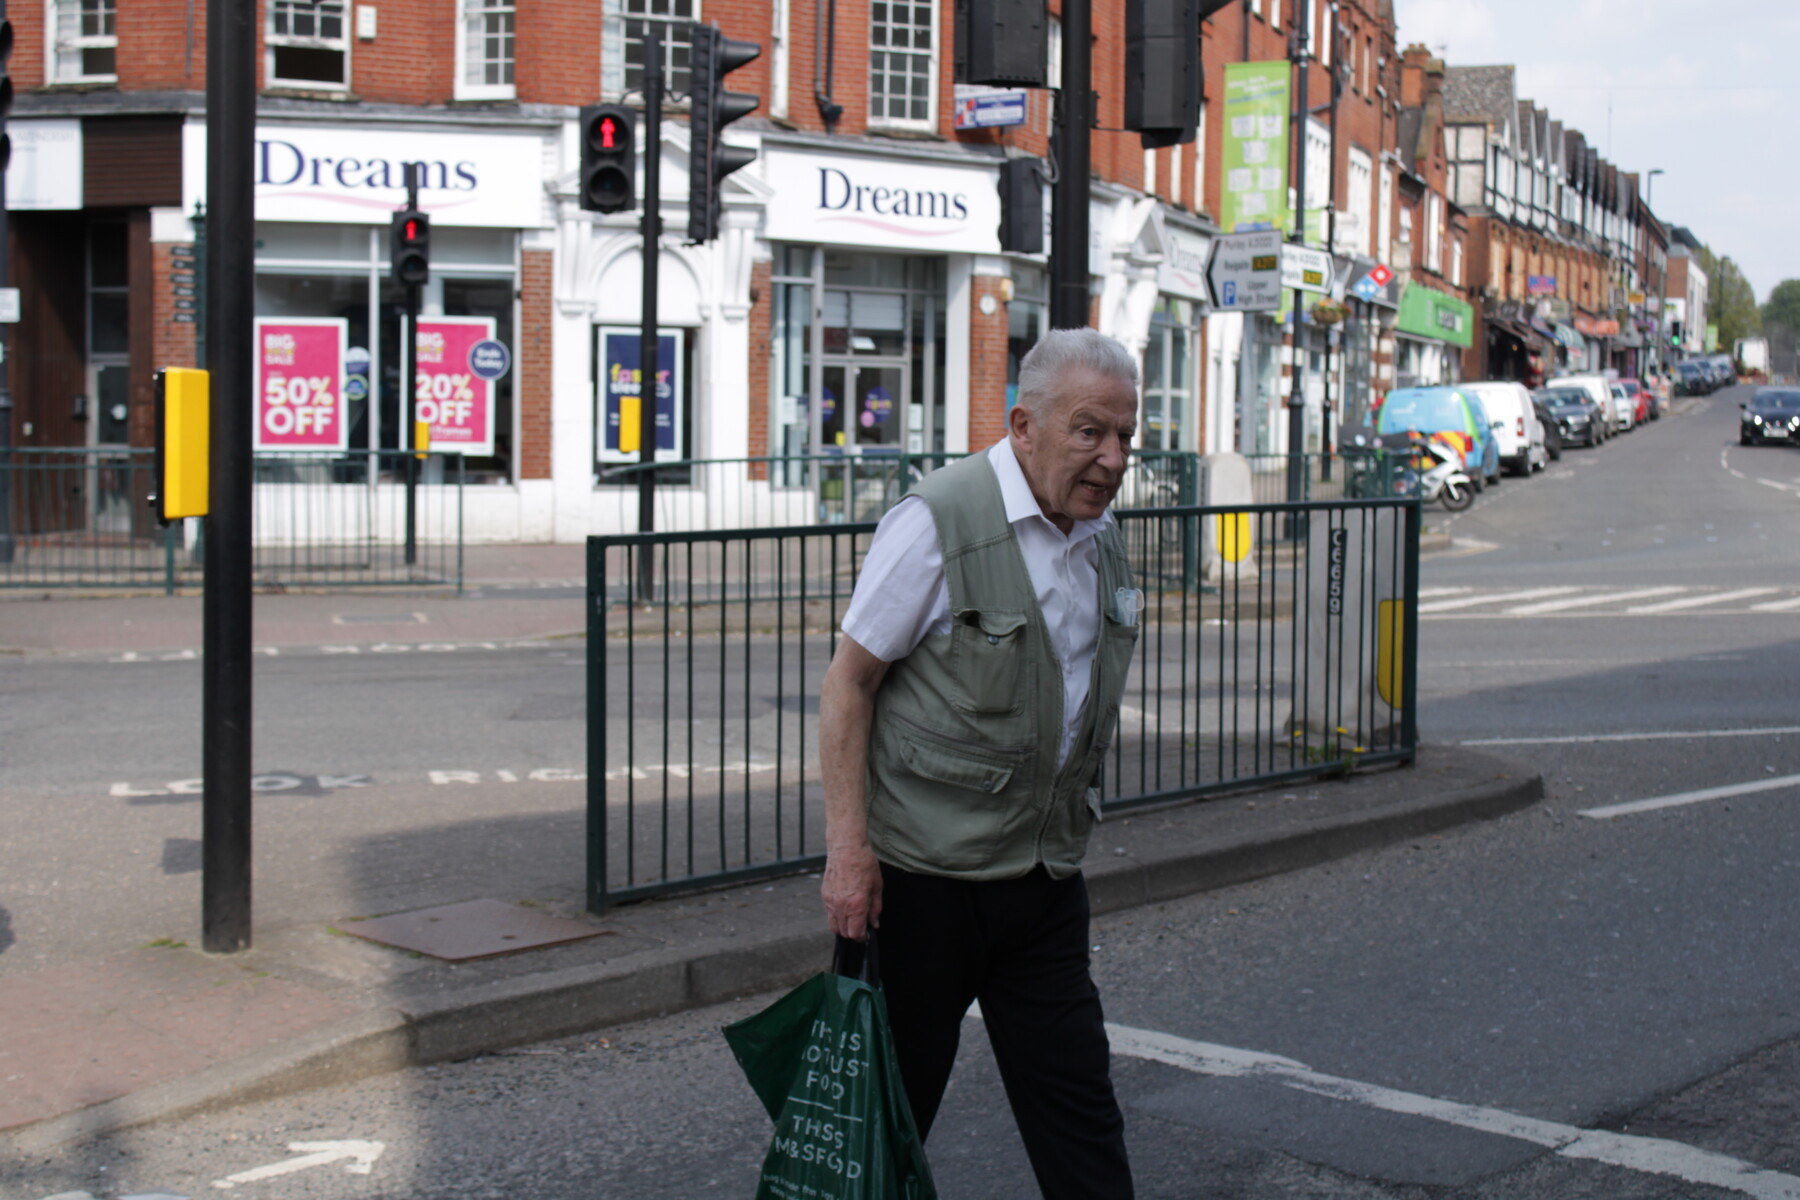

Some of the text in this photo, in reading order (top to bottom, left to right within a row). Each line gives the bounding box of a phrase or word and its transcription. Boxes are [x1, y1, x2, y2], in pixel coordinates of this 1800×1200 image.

[256, 140, 477, 190] Dreams
[817, 167, 968, 220] Dreams
[265, 333, 295, 349] BIG
[265, 376, 335, 406] 50%
[416, 373, 474, 400] 20%
[264, 406, 334, 435] OFF
[416, 400, 473, 425] OFF
